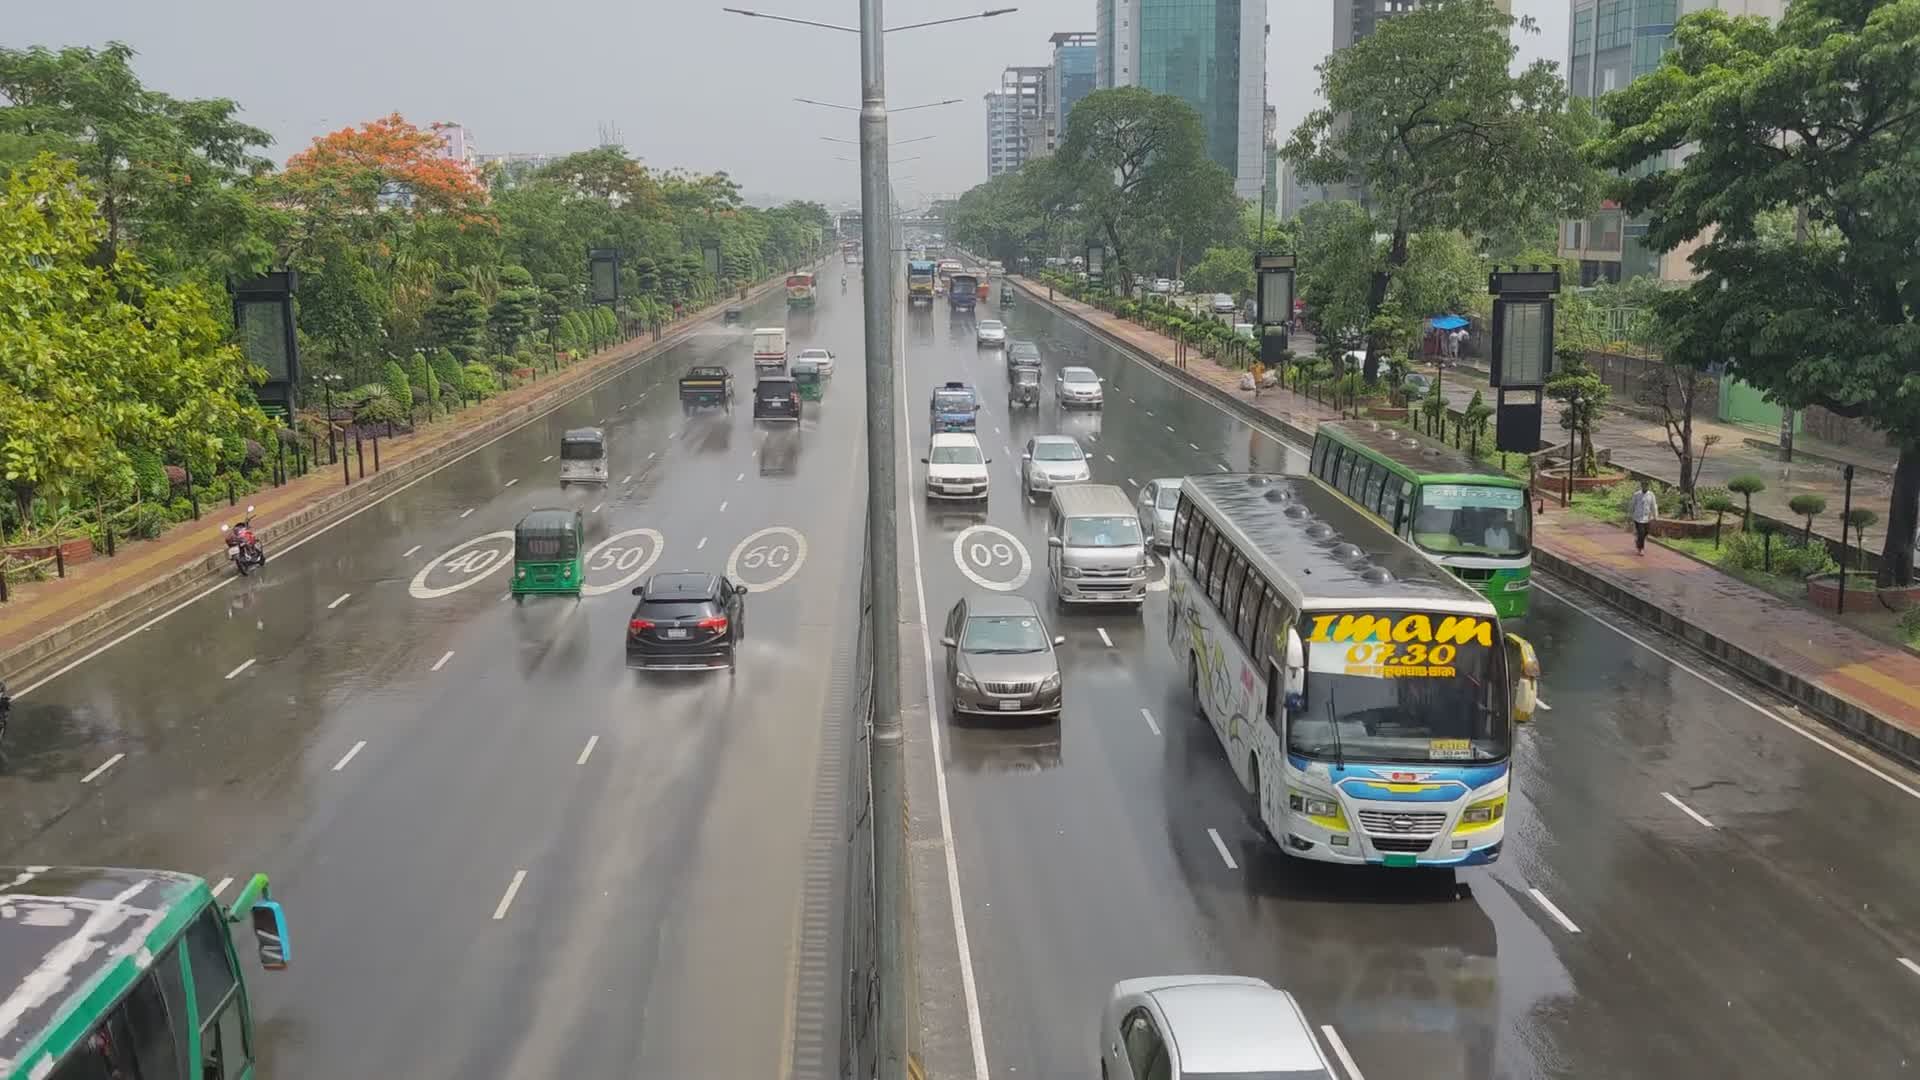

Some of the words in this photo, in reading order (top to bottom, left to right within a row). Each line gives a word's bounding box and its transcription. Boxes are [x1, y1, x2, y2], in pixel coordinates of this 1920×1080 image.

[444, 549, 499, 573] 40
[591, 547, 644, 570] 50
[1345, 643, 1457, 665] 07.30
